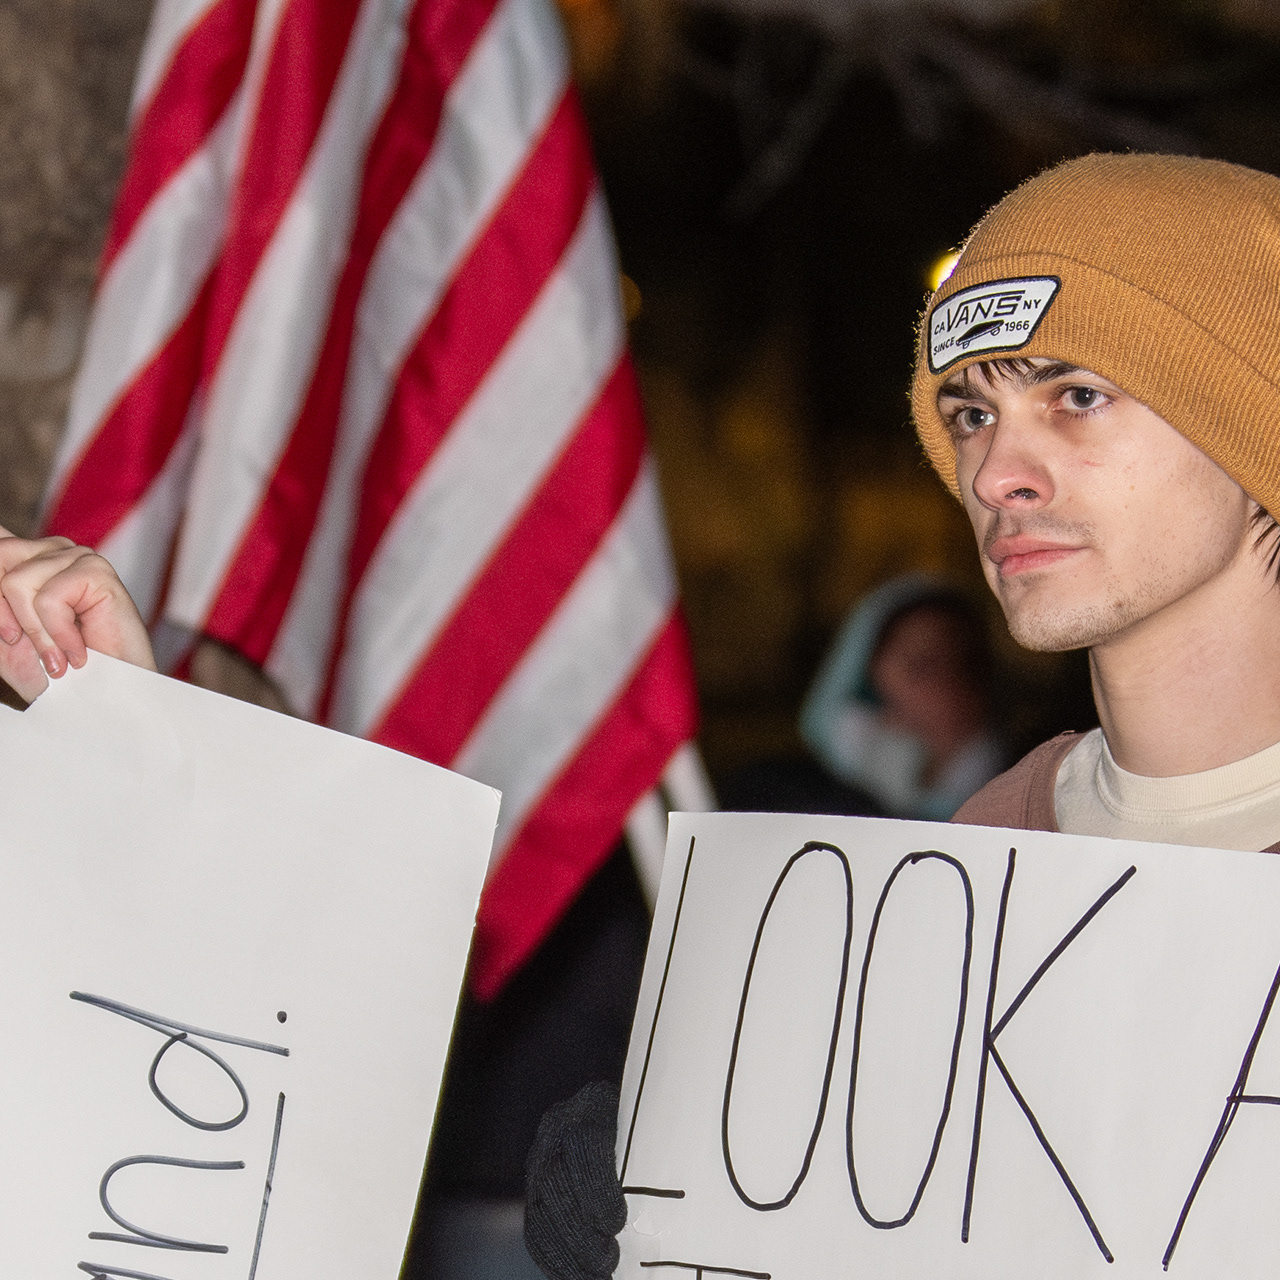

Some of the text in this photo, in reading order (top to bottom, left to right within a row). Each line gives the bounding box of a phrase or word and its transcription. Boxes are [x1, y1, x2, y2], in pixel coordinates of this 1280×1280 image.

[933, 290, 1042, 335] CA VANS NY
[933, 320, 1030, 356] SINCE 1966
[619, 835, 1137, 1264] LOOK
